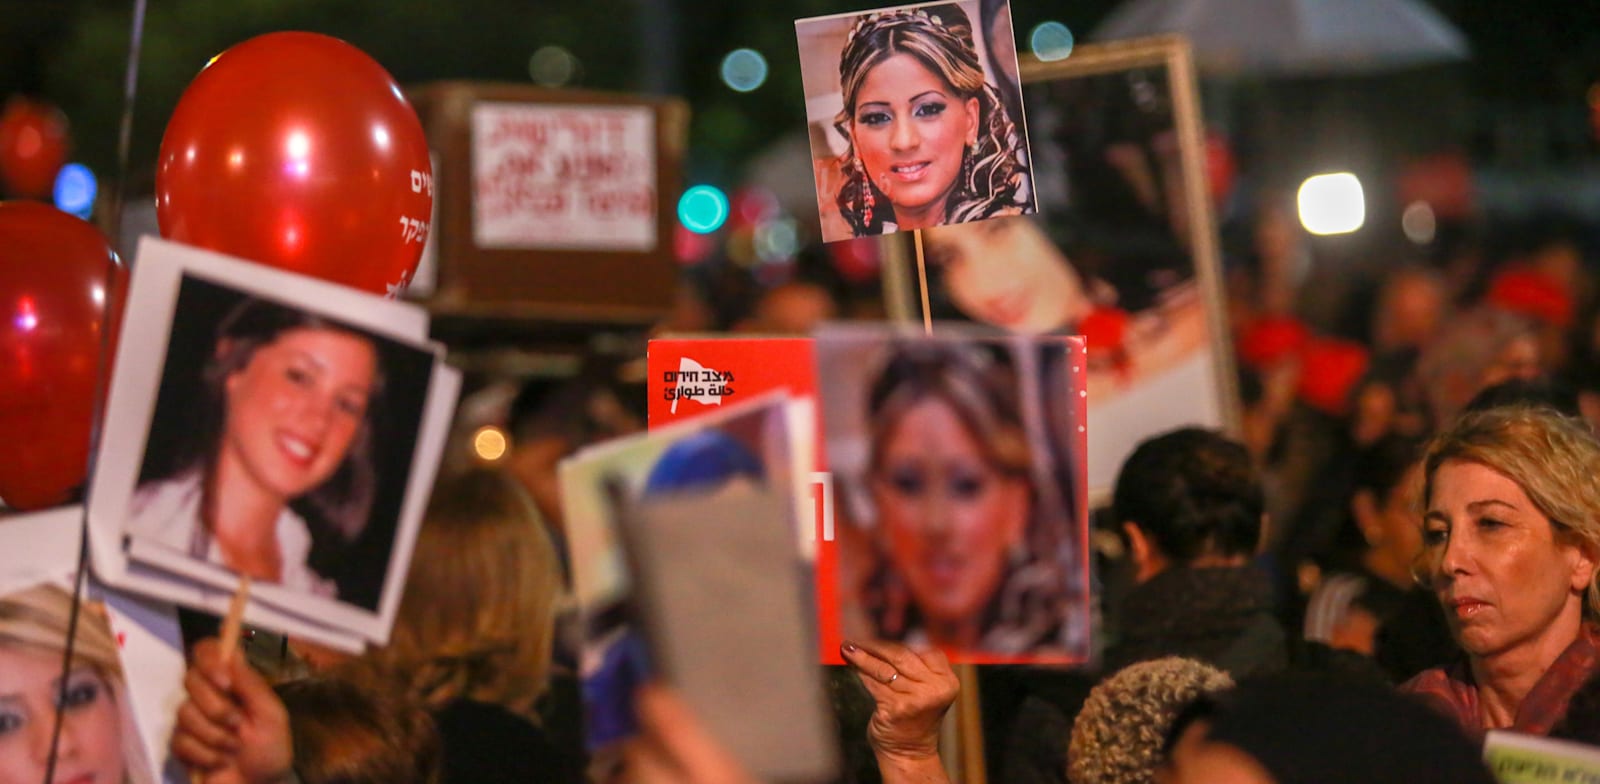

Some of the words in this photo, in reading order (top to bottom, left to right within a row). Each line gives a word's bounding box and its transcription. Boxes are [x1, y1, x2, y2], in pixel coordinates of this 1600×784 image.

[664, 371, 698, 382] חירום
[702, 371, 735, 382] מצב
[664, 385, 705, 401] طوارئ
[708, 384, 735, 396] حالة
